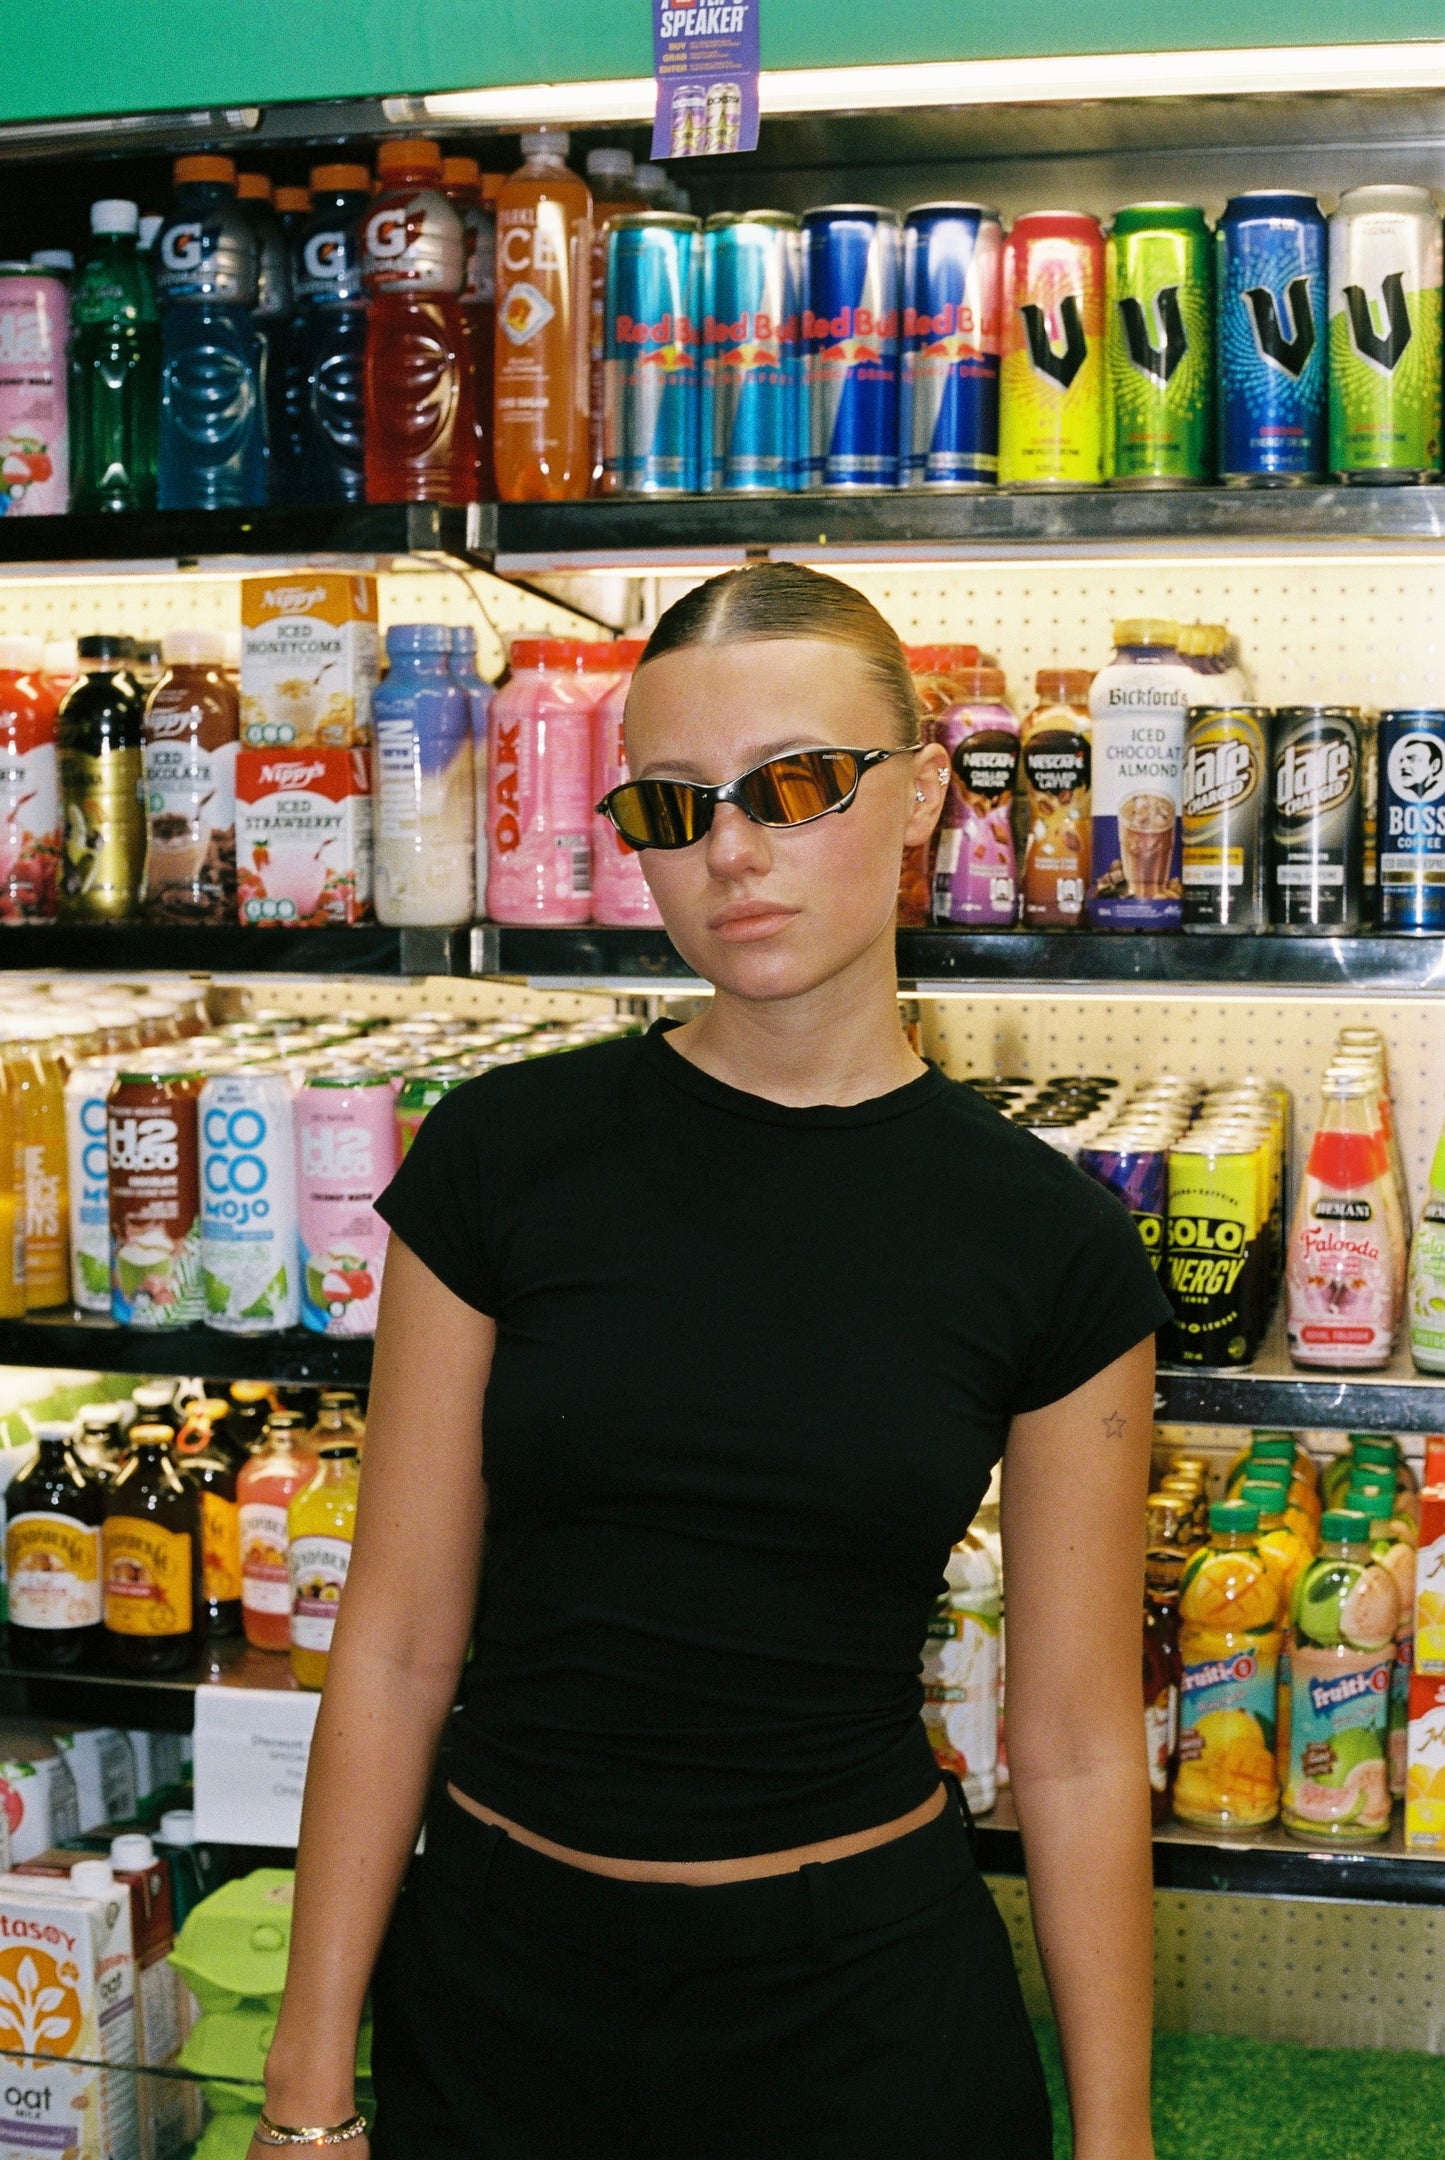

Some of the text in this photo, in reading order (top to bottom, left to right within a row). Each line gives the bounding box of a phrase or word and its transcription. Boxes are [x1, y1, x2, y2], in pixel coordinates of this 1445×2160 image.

[161, 222, 203, 271] G
[366, 207, 407, 258] G
[303, 231, 346, 279] G
[616, 313, 671, 344] Red
[1106, 745, 1181, 760] CHOCOLAT
[1131, 729, 1165, 742] ICED
[1119, 763, 1178, 777] ALMOND
[1277, 740, 1350, 807] dare
[495, 721, 521, 855] OAK
[1389, 806, 1445, 836] BOSS
[1300, 1226, 1379, 1261] Falooda
[1169, 1257, 1246, 1295] NERGY
[5, 2086, 52, 2111] oat
